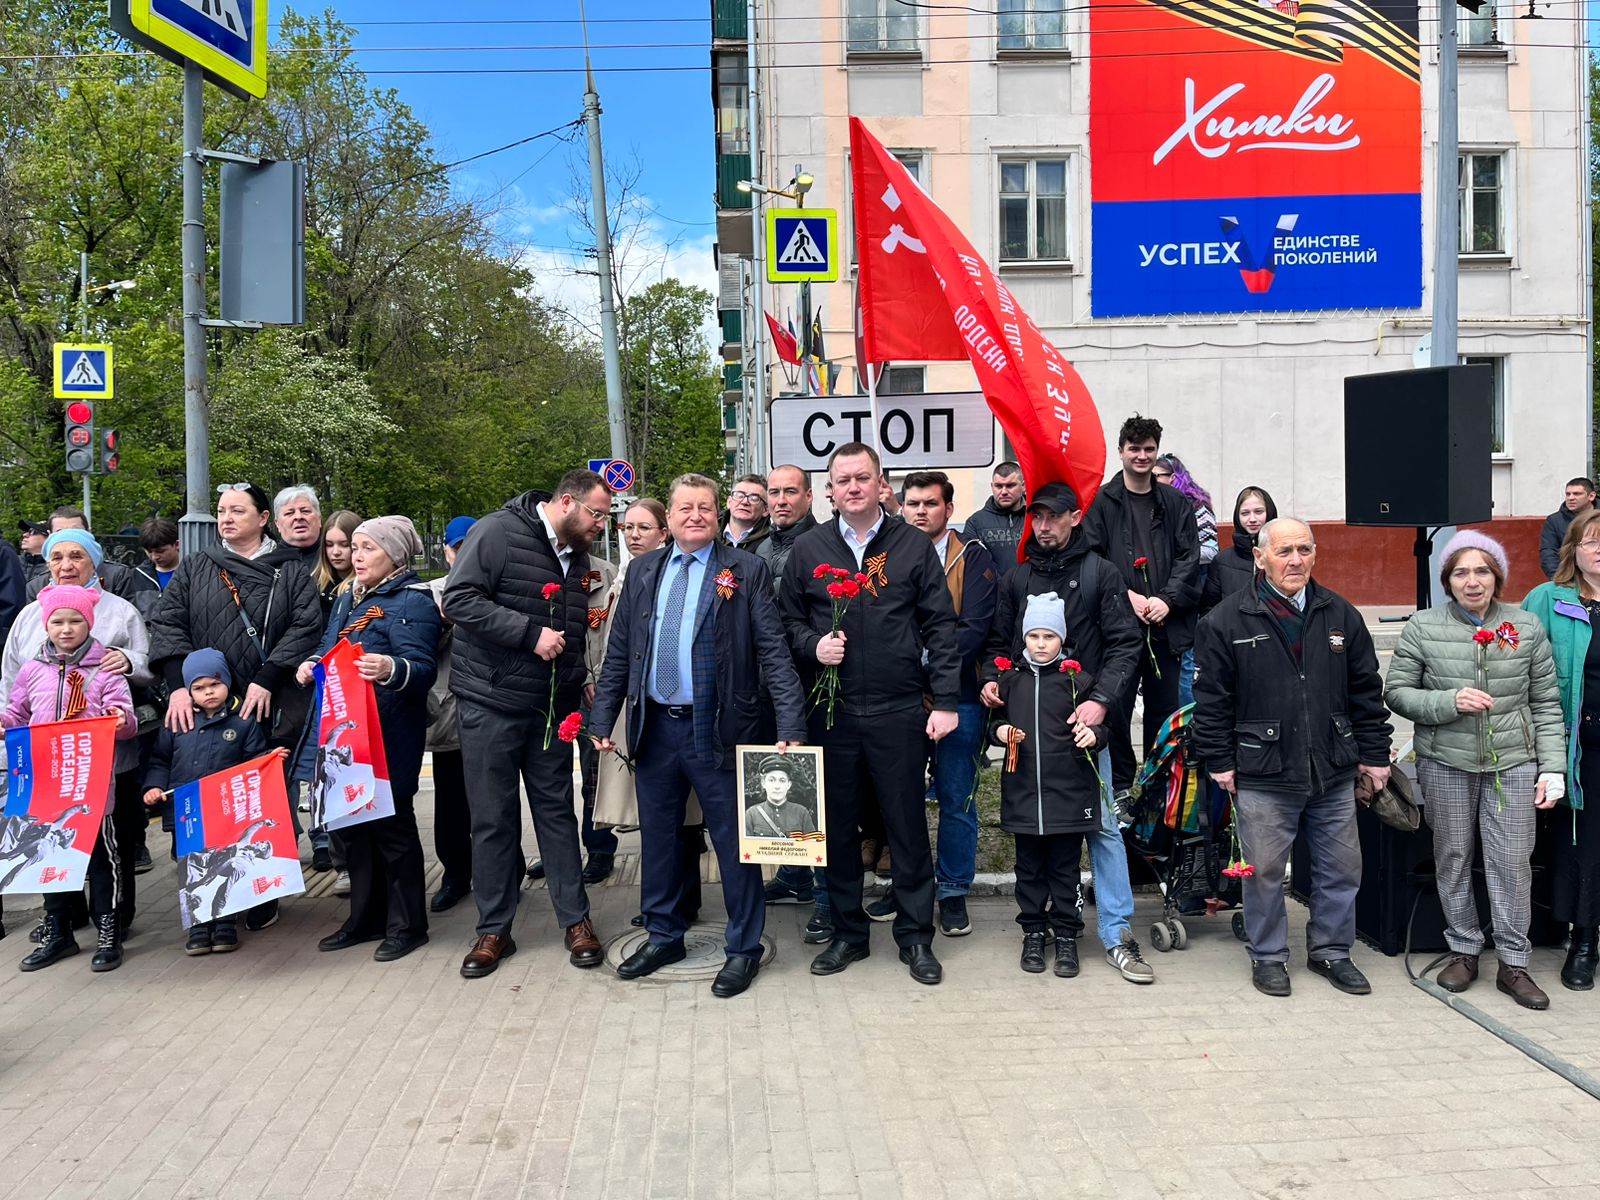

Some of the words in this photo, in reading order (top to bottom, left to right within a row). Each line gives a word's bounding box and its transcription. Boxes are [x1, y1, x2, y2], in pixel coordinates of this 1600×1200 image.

[1153, 73, 1358, 166] Химки
[1138, 241, 1242, 267] УСПЕХ
[1273, 235, 1360, 251] ЕДИНСТВЕ
[1273, 248, 1377, 265] ПОКОЛЕНИЙ
[802, 408, 954, 457] СТОП
[326, 658, 347, 721] РДИМСЯ
[59, 732, 75, 798] ПОБЕДОЙ!
[72, 731, 92, 802] ГОРДИМСЯ
